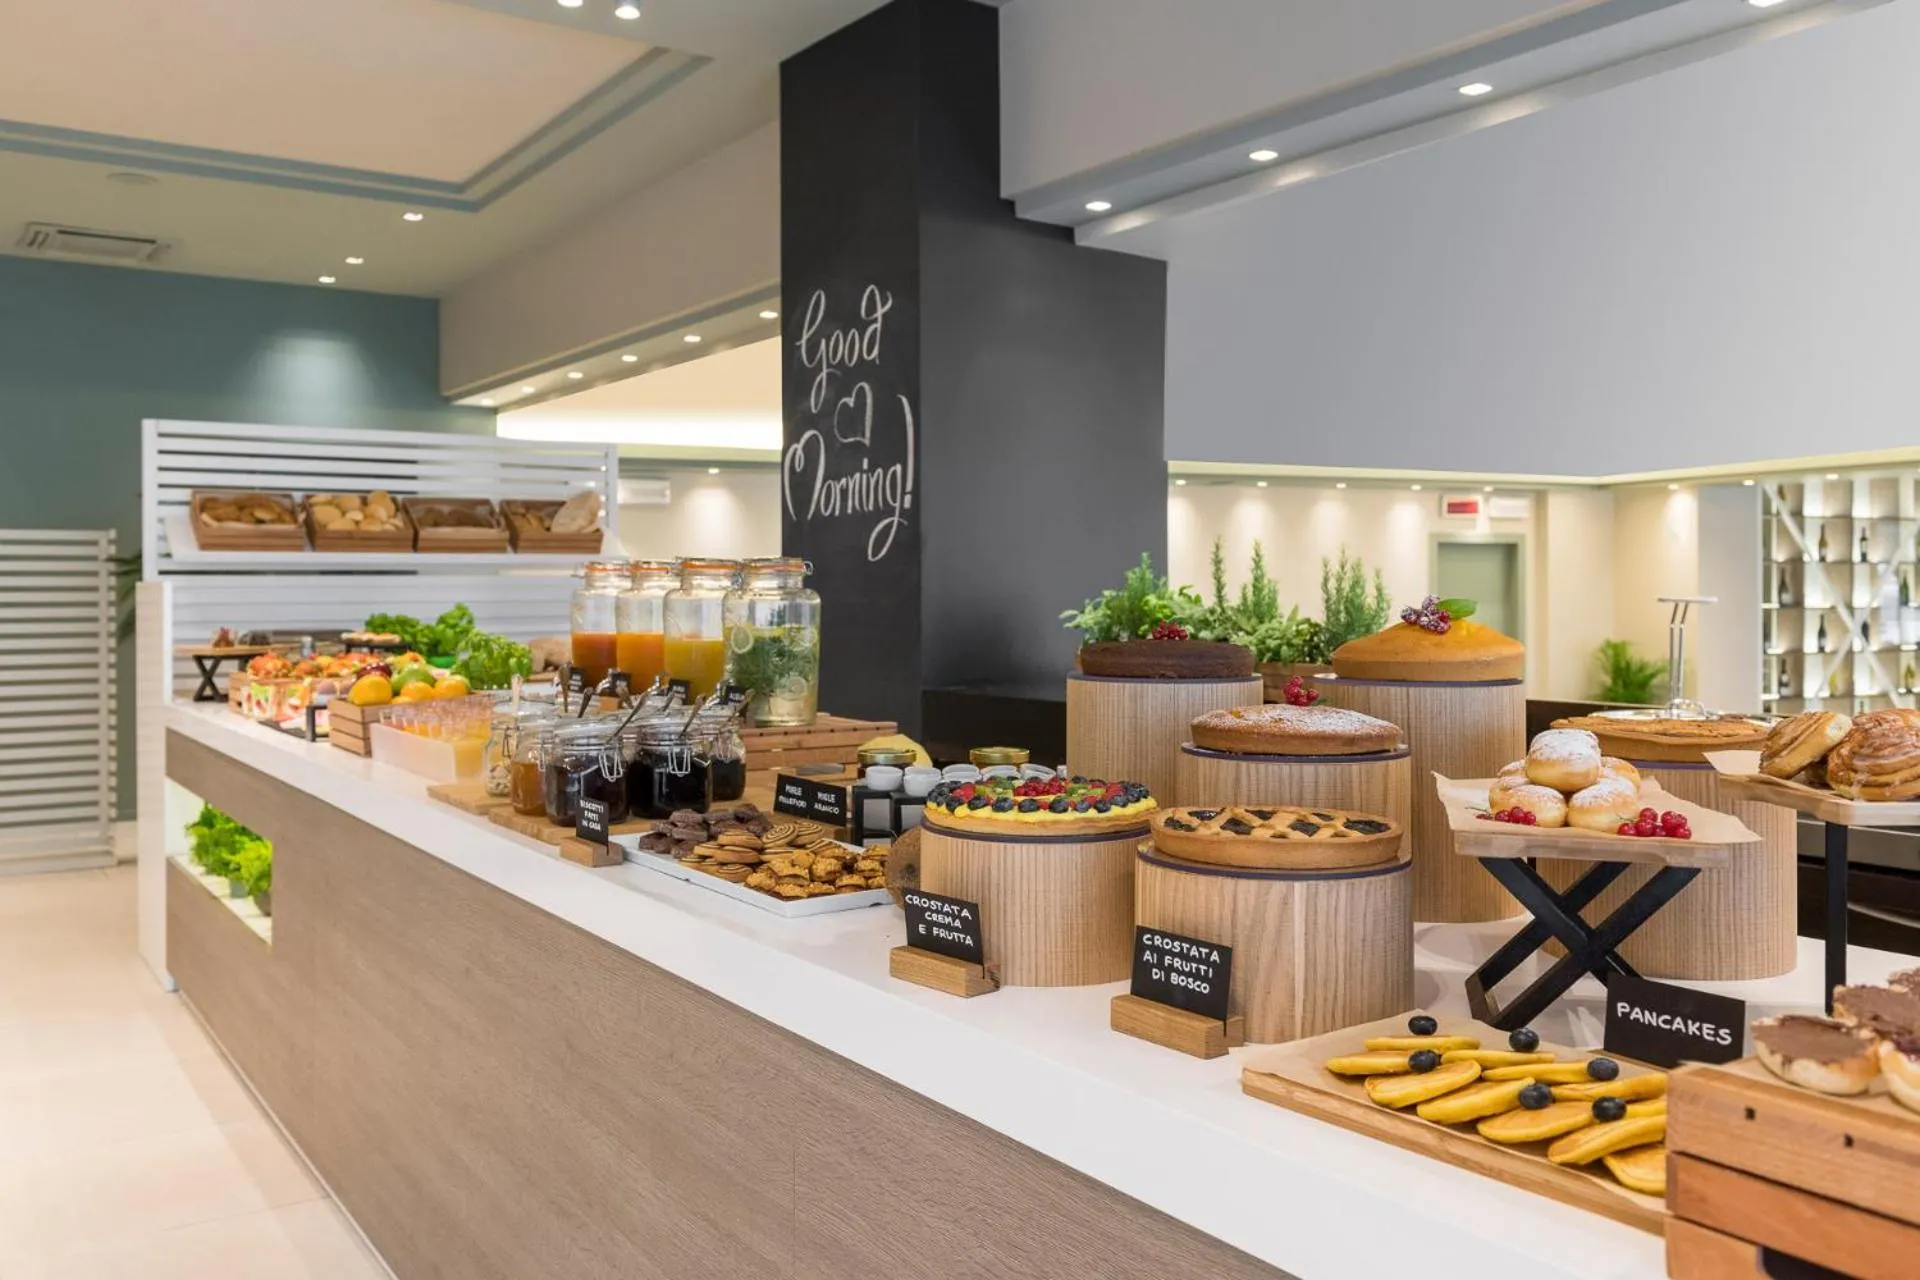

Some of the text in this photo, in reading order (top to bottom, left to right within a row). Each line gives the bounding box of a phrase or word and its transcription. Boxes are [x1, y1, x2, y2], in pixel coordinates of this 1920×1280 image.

[796, 284, 893, 413] Good
[784, 394, 914, 562] Morning!
[905, 894, 973, 921] CROSTATA
[924, 911, 962, 929] CREMA
[918, 924, 974, 947] E FRUTTA
[1142, 934, 1220, 963] CROSTATA
[1143, 950, 1213, 979] AI FRUTTI
[1151, 968, 1210, 994] DI BOSCO
[1616, 1001, 1733, 1046] PANCAKES
